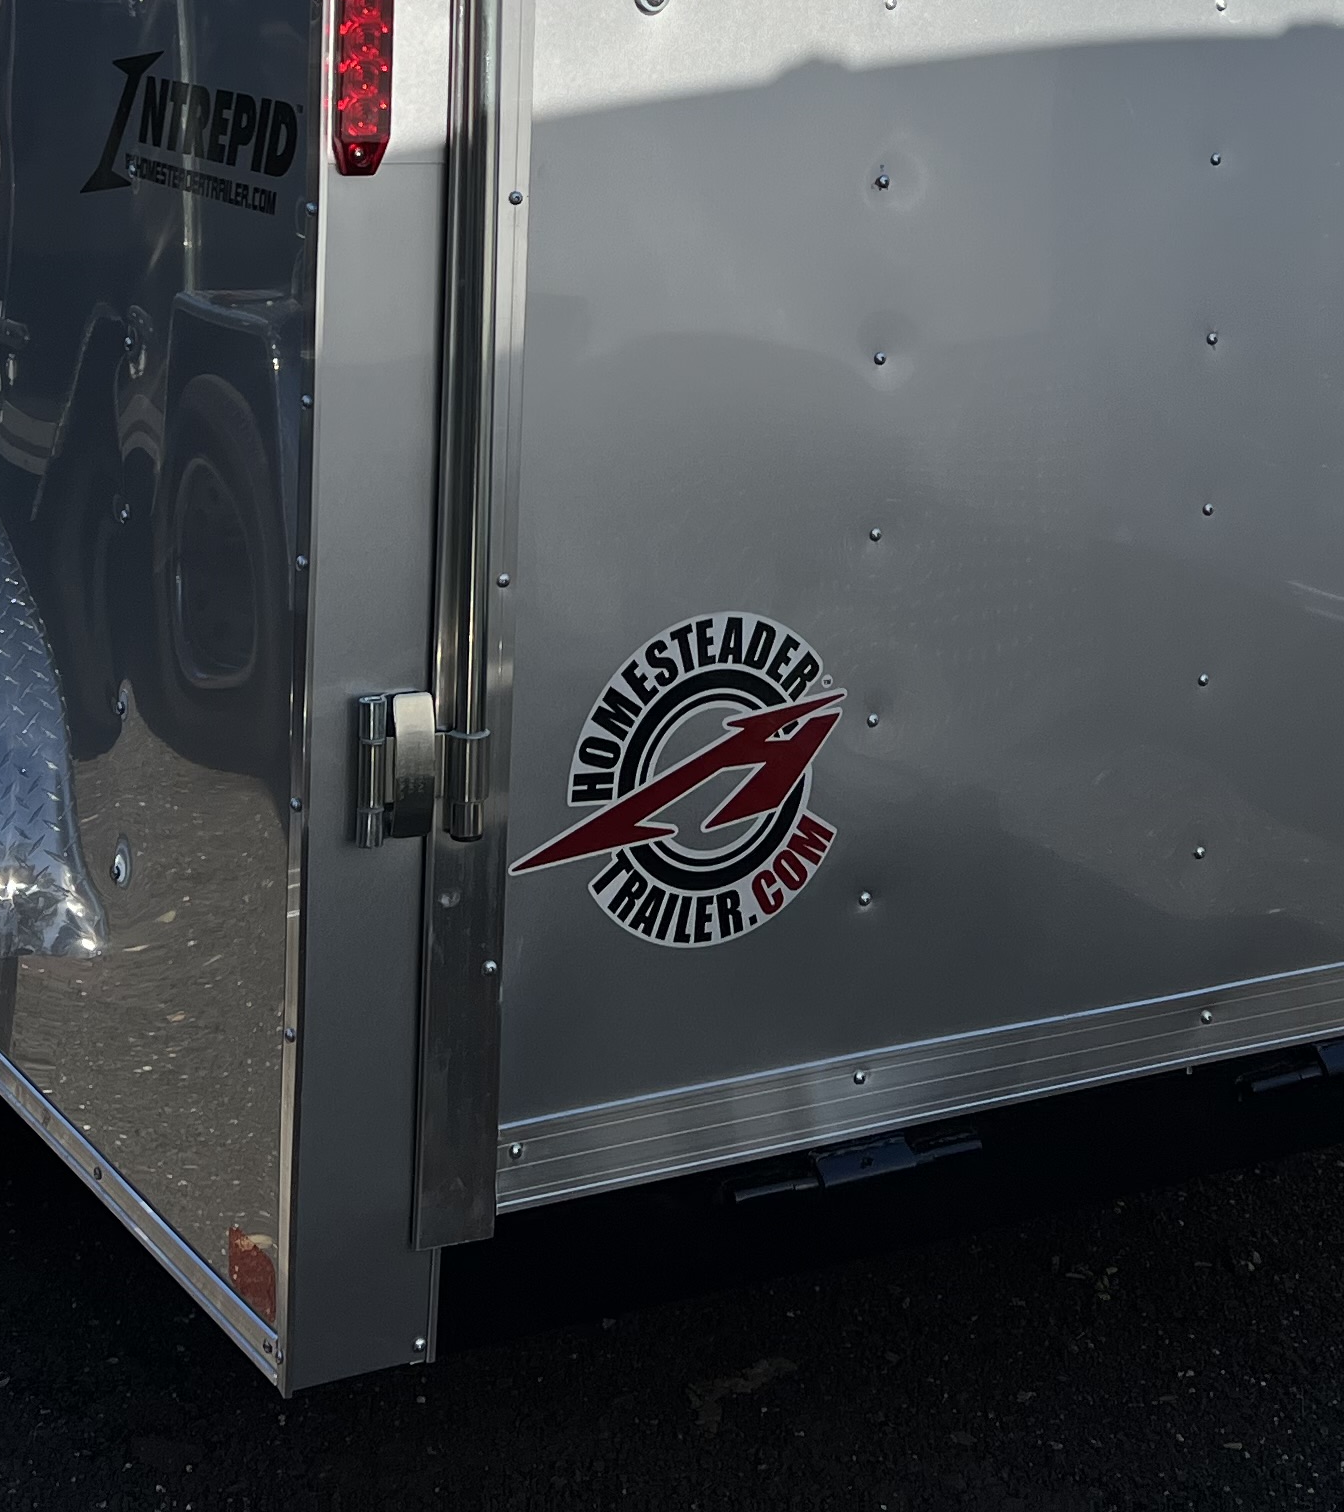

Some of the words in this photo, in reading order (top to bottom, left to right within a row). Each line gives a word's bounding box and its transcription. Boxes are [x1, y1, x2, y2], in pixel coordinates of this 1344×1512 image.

[80, 50, 298, 193] INTREPID
[571, 616, 821, 803] HOMESTEADER
[592, 813, 835, 944] TRAILER.COM
